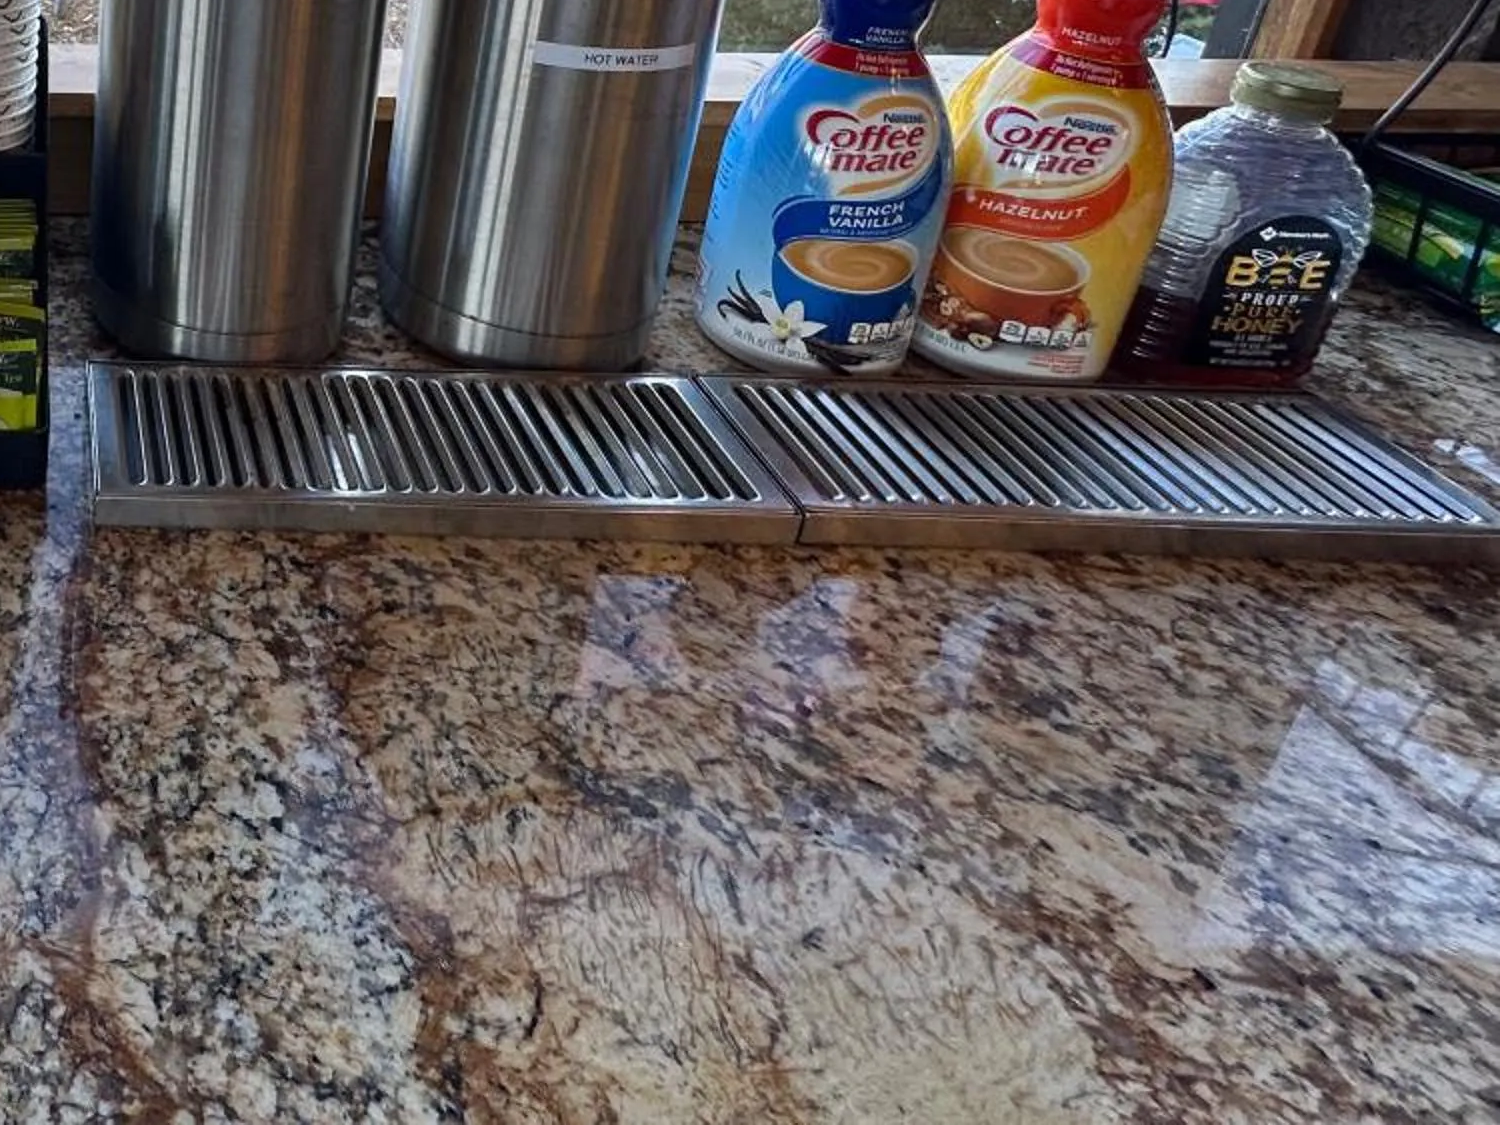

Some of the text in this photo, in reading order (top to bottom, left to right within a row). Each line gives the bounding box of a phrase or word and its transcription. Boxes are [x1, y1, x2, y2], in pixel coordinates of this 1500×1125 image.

[1060, 26, 1122, 46] HAZELNUT
[584, 53, 659, 66] HOT WATER
[806, 110, 924, 152] Coffee
[985, 106, 1112, 156] Coffee
[831, 150, 917, 172] mate
[996, 148, 1095, 175] mate
[829, 201, 905, 217] FRENCH
[979, 198, 1089, 220] HAZELNUT
[829, 215, 903, 228] VANILLA
[1225, 255, 1331, 289] BEE
[1241, 292, 1299, 306] PROUD
[1232, 303, 1294, 317] PURE
[1211, 316, 1304, 334] HONEY
